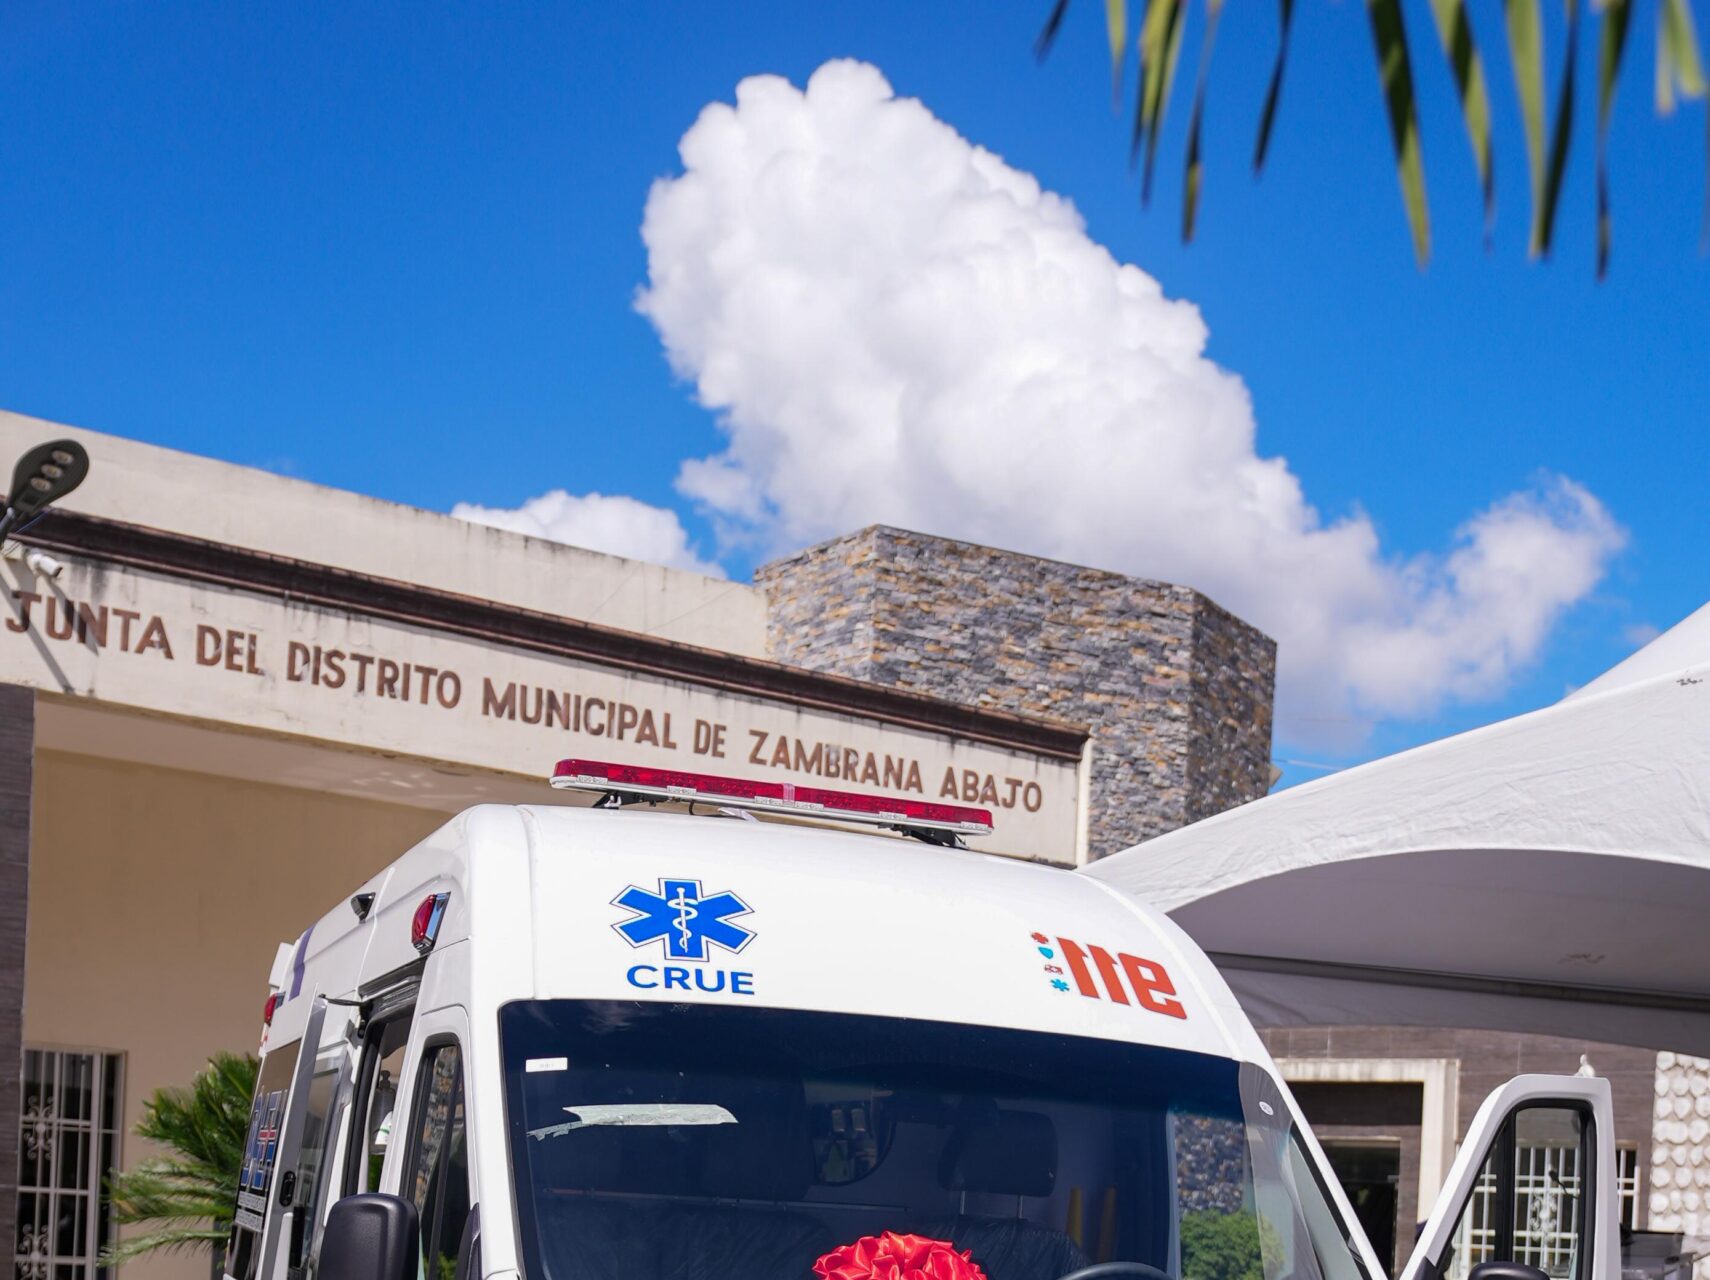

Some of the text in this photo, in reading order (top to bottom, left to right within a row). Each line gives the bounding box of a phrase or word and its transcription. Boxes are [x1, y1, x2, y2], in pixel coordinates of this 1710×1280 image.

[6, 590, 1043, 813] JUNTA DEL DISTRITO MUNICIPAL DE ZAMBRANA ABAJO
[626, 965, 755, 995] CRUE
